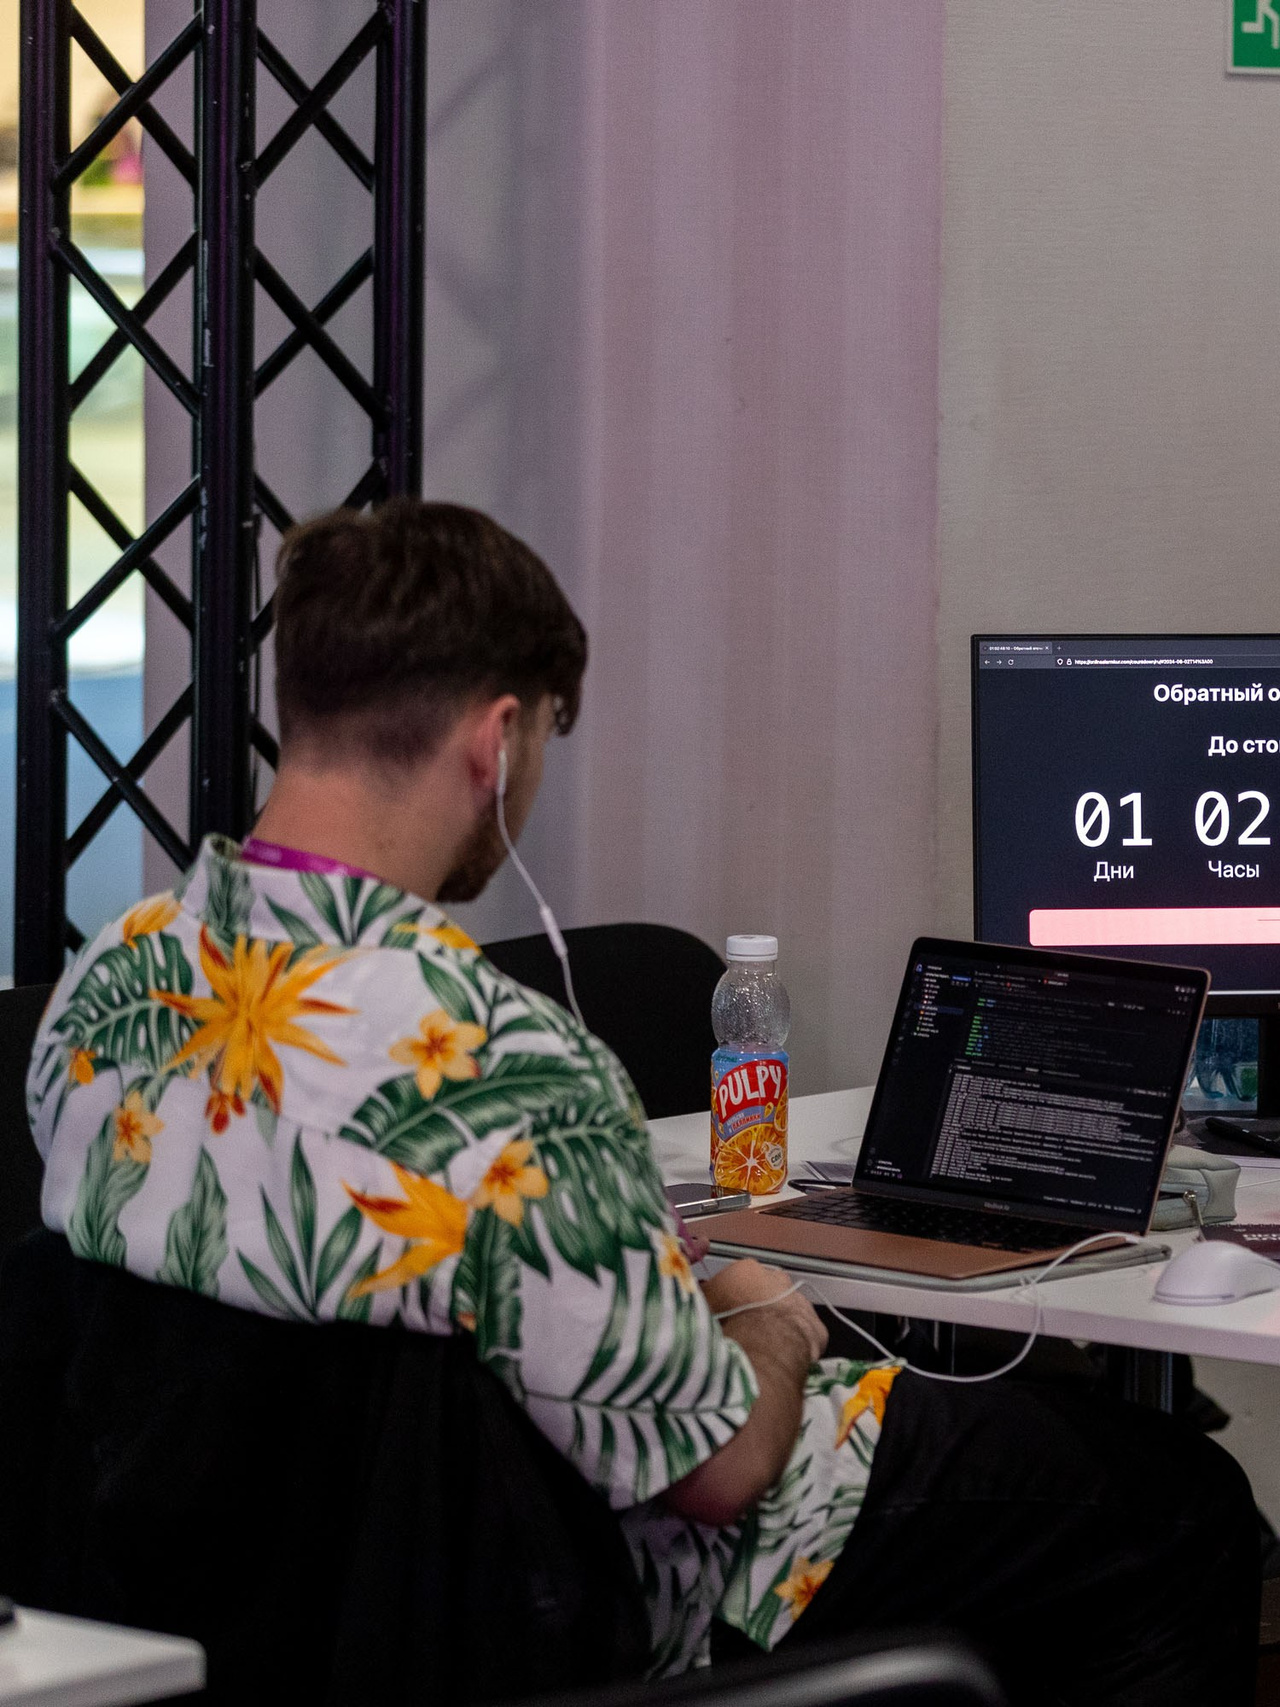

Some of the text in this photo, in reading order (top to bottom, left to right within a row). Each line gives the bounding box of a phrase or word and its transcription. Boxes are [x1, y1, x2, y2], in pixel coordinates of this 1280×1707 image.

[1153, 682, 1264, 706] Обратный
[1207, 735, 1239, 757] До
[1074, 791, 1153, 848] 01
[1194, 790, 1271, 847] 02
[1093, 861, 1134, 883] Дни
[1207, 860, 1260, 879] Часы
[719, 1066, 782, 1119] PULPY
